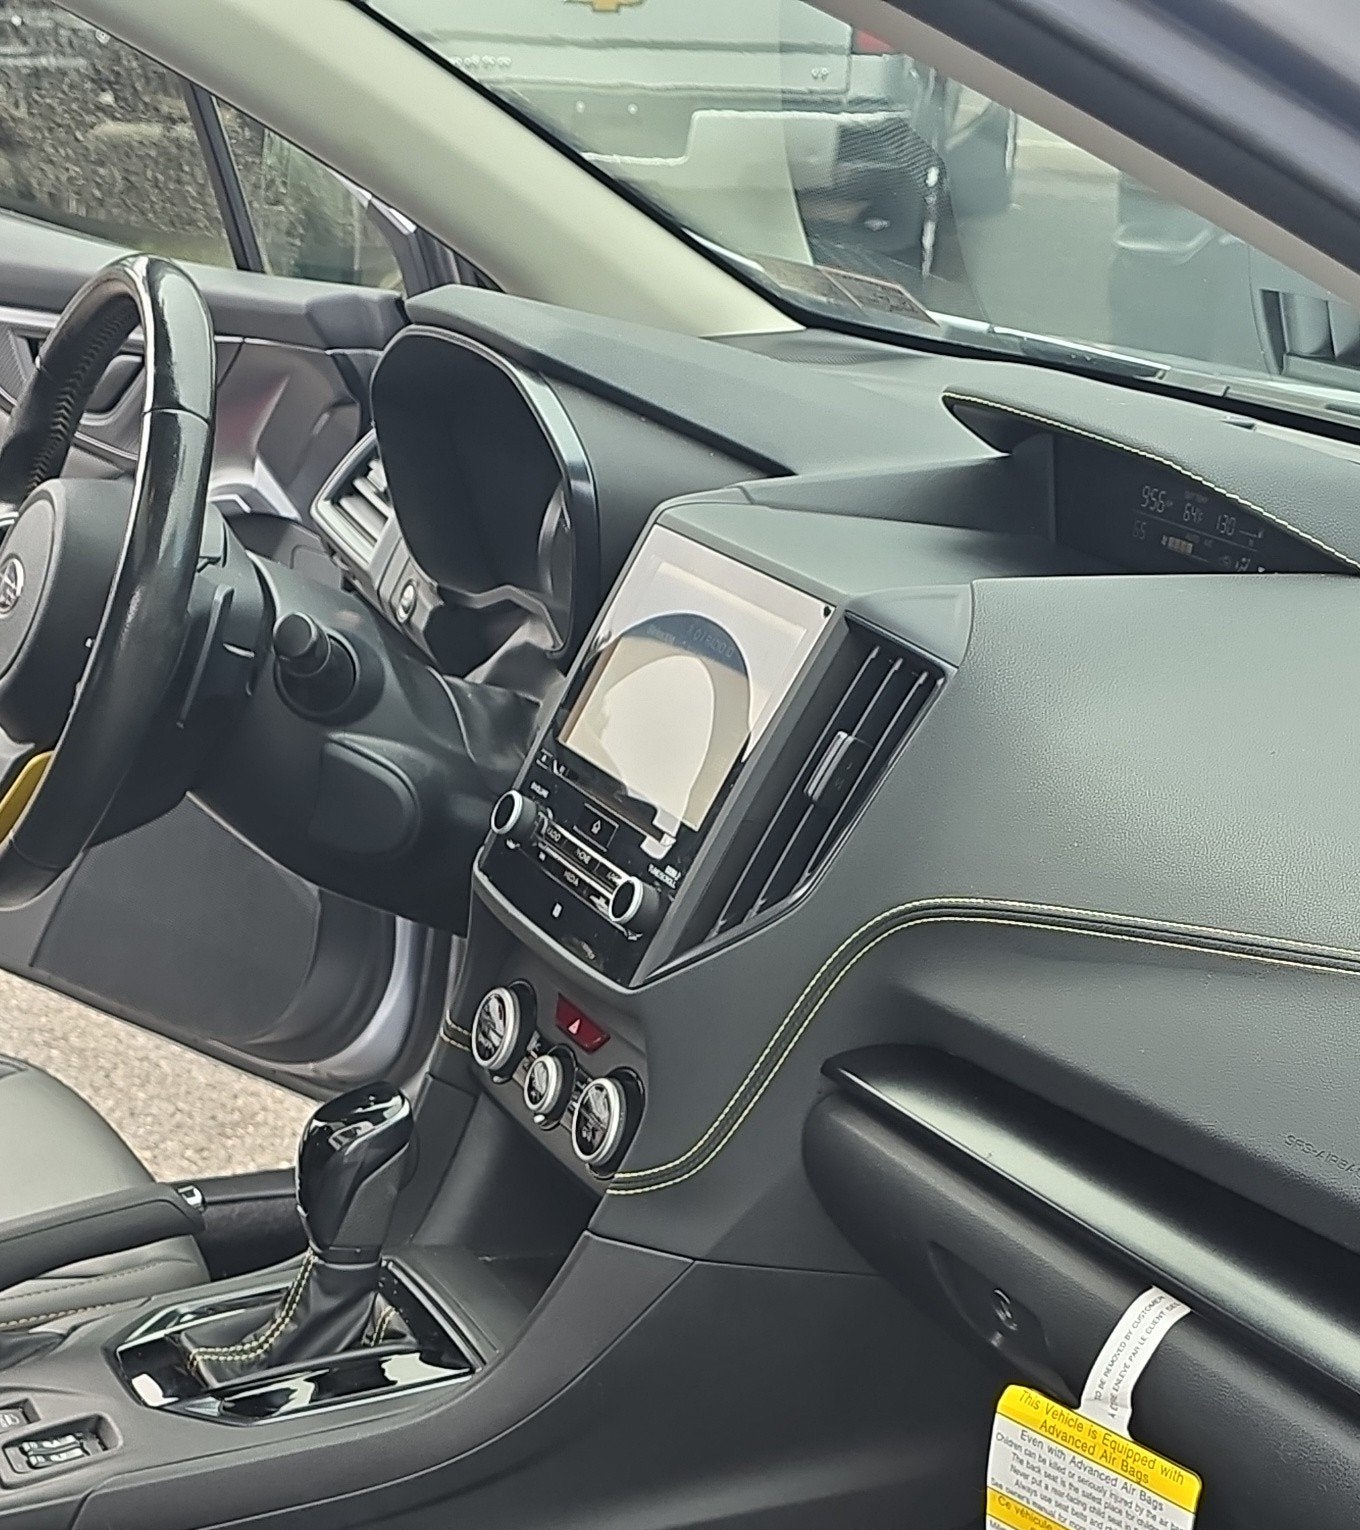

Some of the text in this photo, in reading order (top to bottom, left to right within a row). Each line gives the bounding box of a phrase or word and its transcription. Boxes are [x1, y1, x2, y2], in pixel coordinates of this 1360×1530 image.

[1019, 1389, 1184, 1484] This Vehicle is Equipped with
[1020, 1429, 1163, 1513] Even with Advanced Air Bags
[1039, 1417, 1149, 1486] Advanced Air Bags
